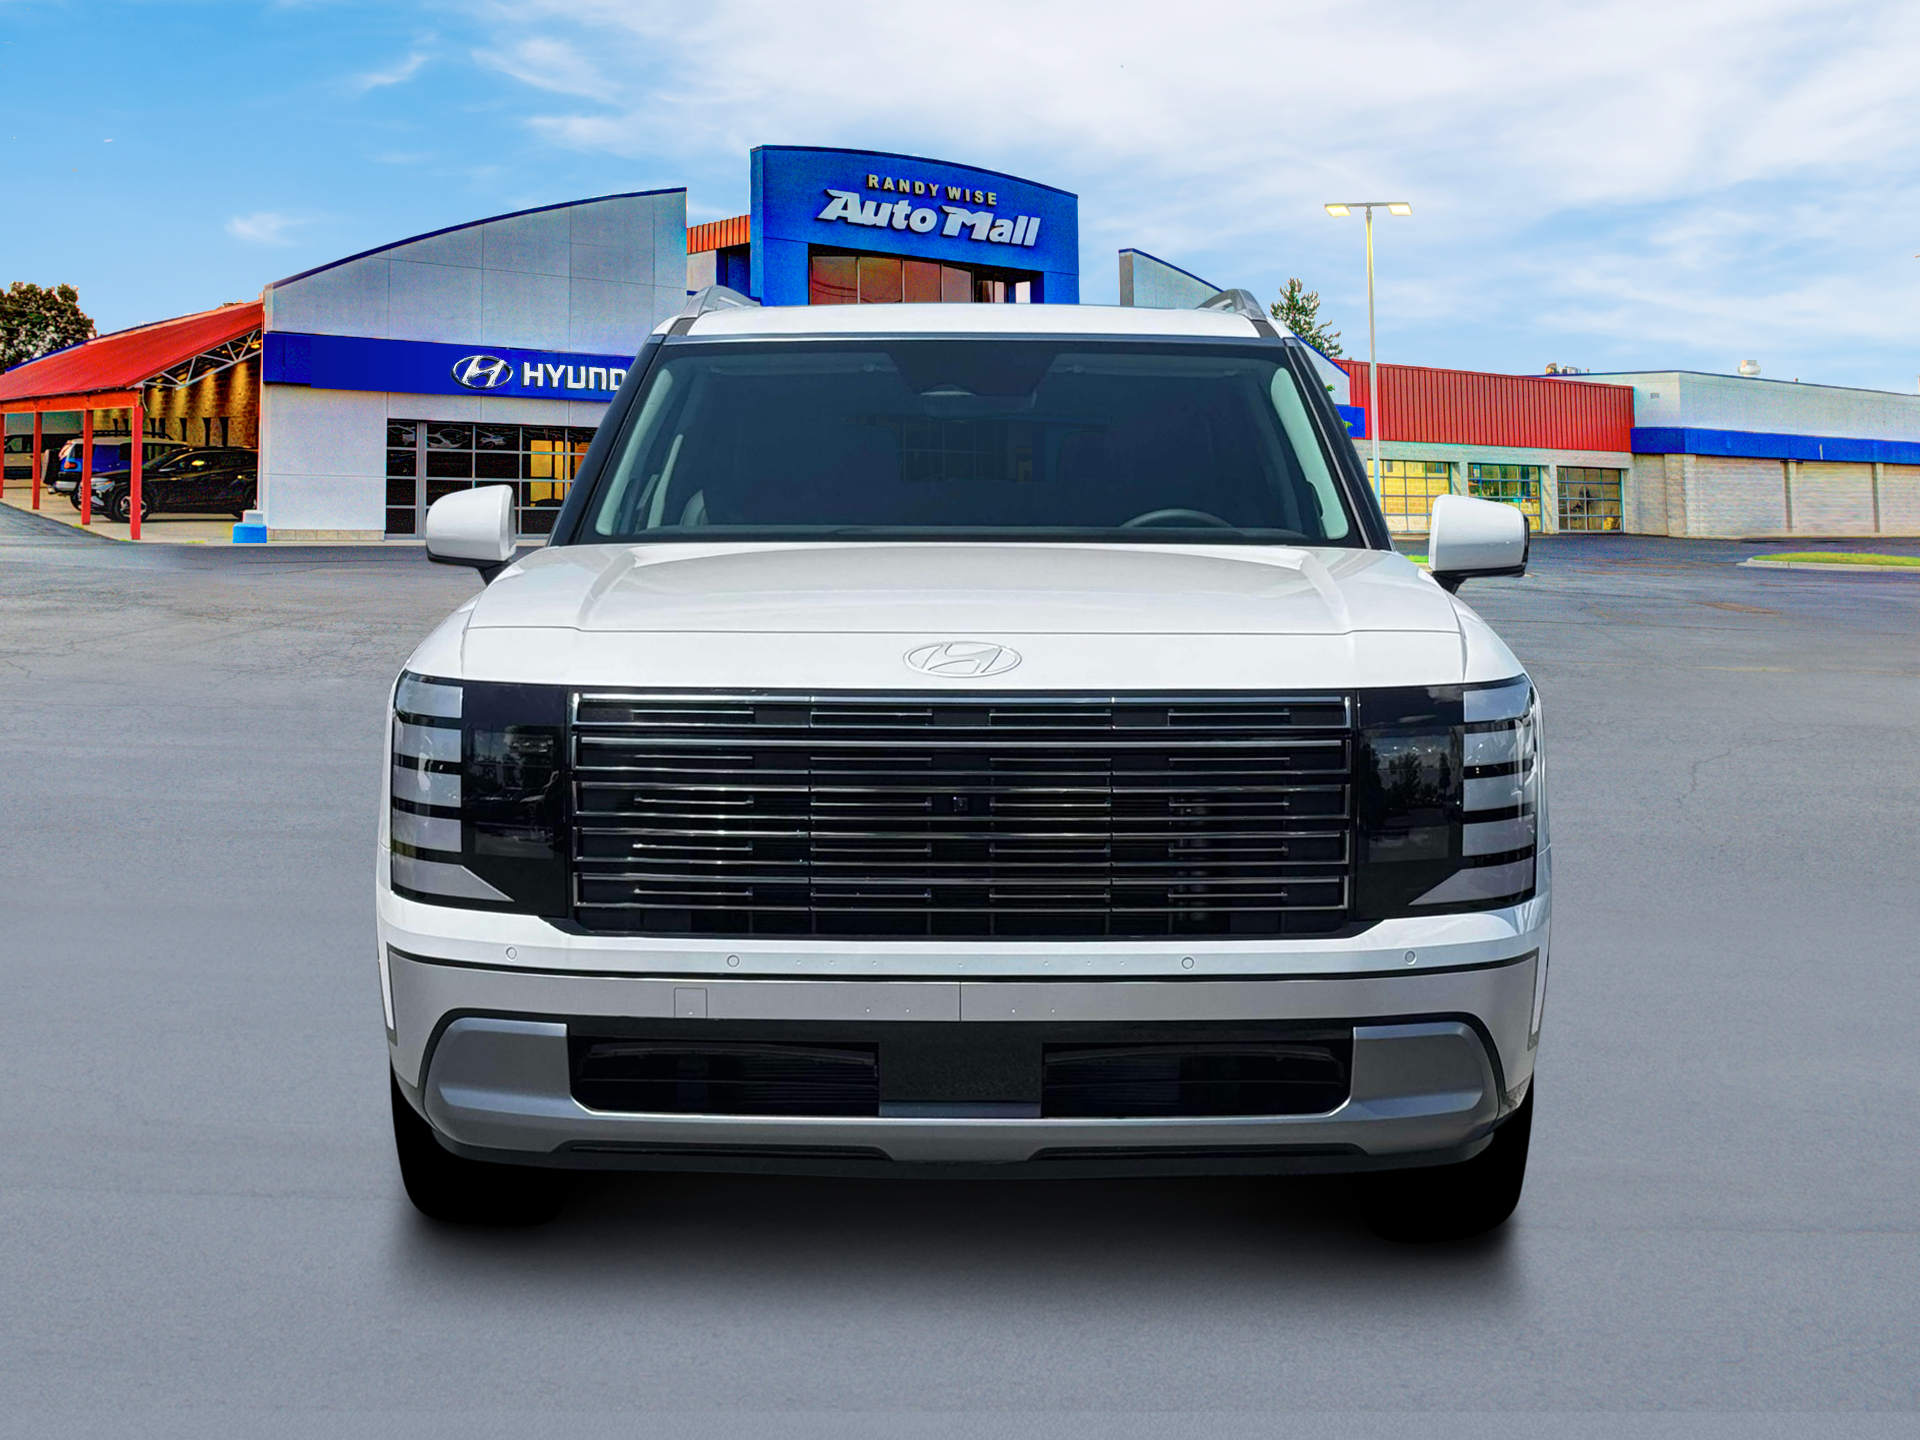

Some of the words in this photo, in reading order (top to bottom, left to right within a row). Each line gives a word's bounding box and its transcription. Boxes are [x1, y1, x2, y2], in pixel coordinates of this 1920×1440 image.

[866, 174, 940, 198] RANDY
[946, 186, 998, 206] WISE
[815, 188, 938, 234] Auto
[941, 204, 1042, 247] Mall
